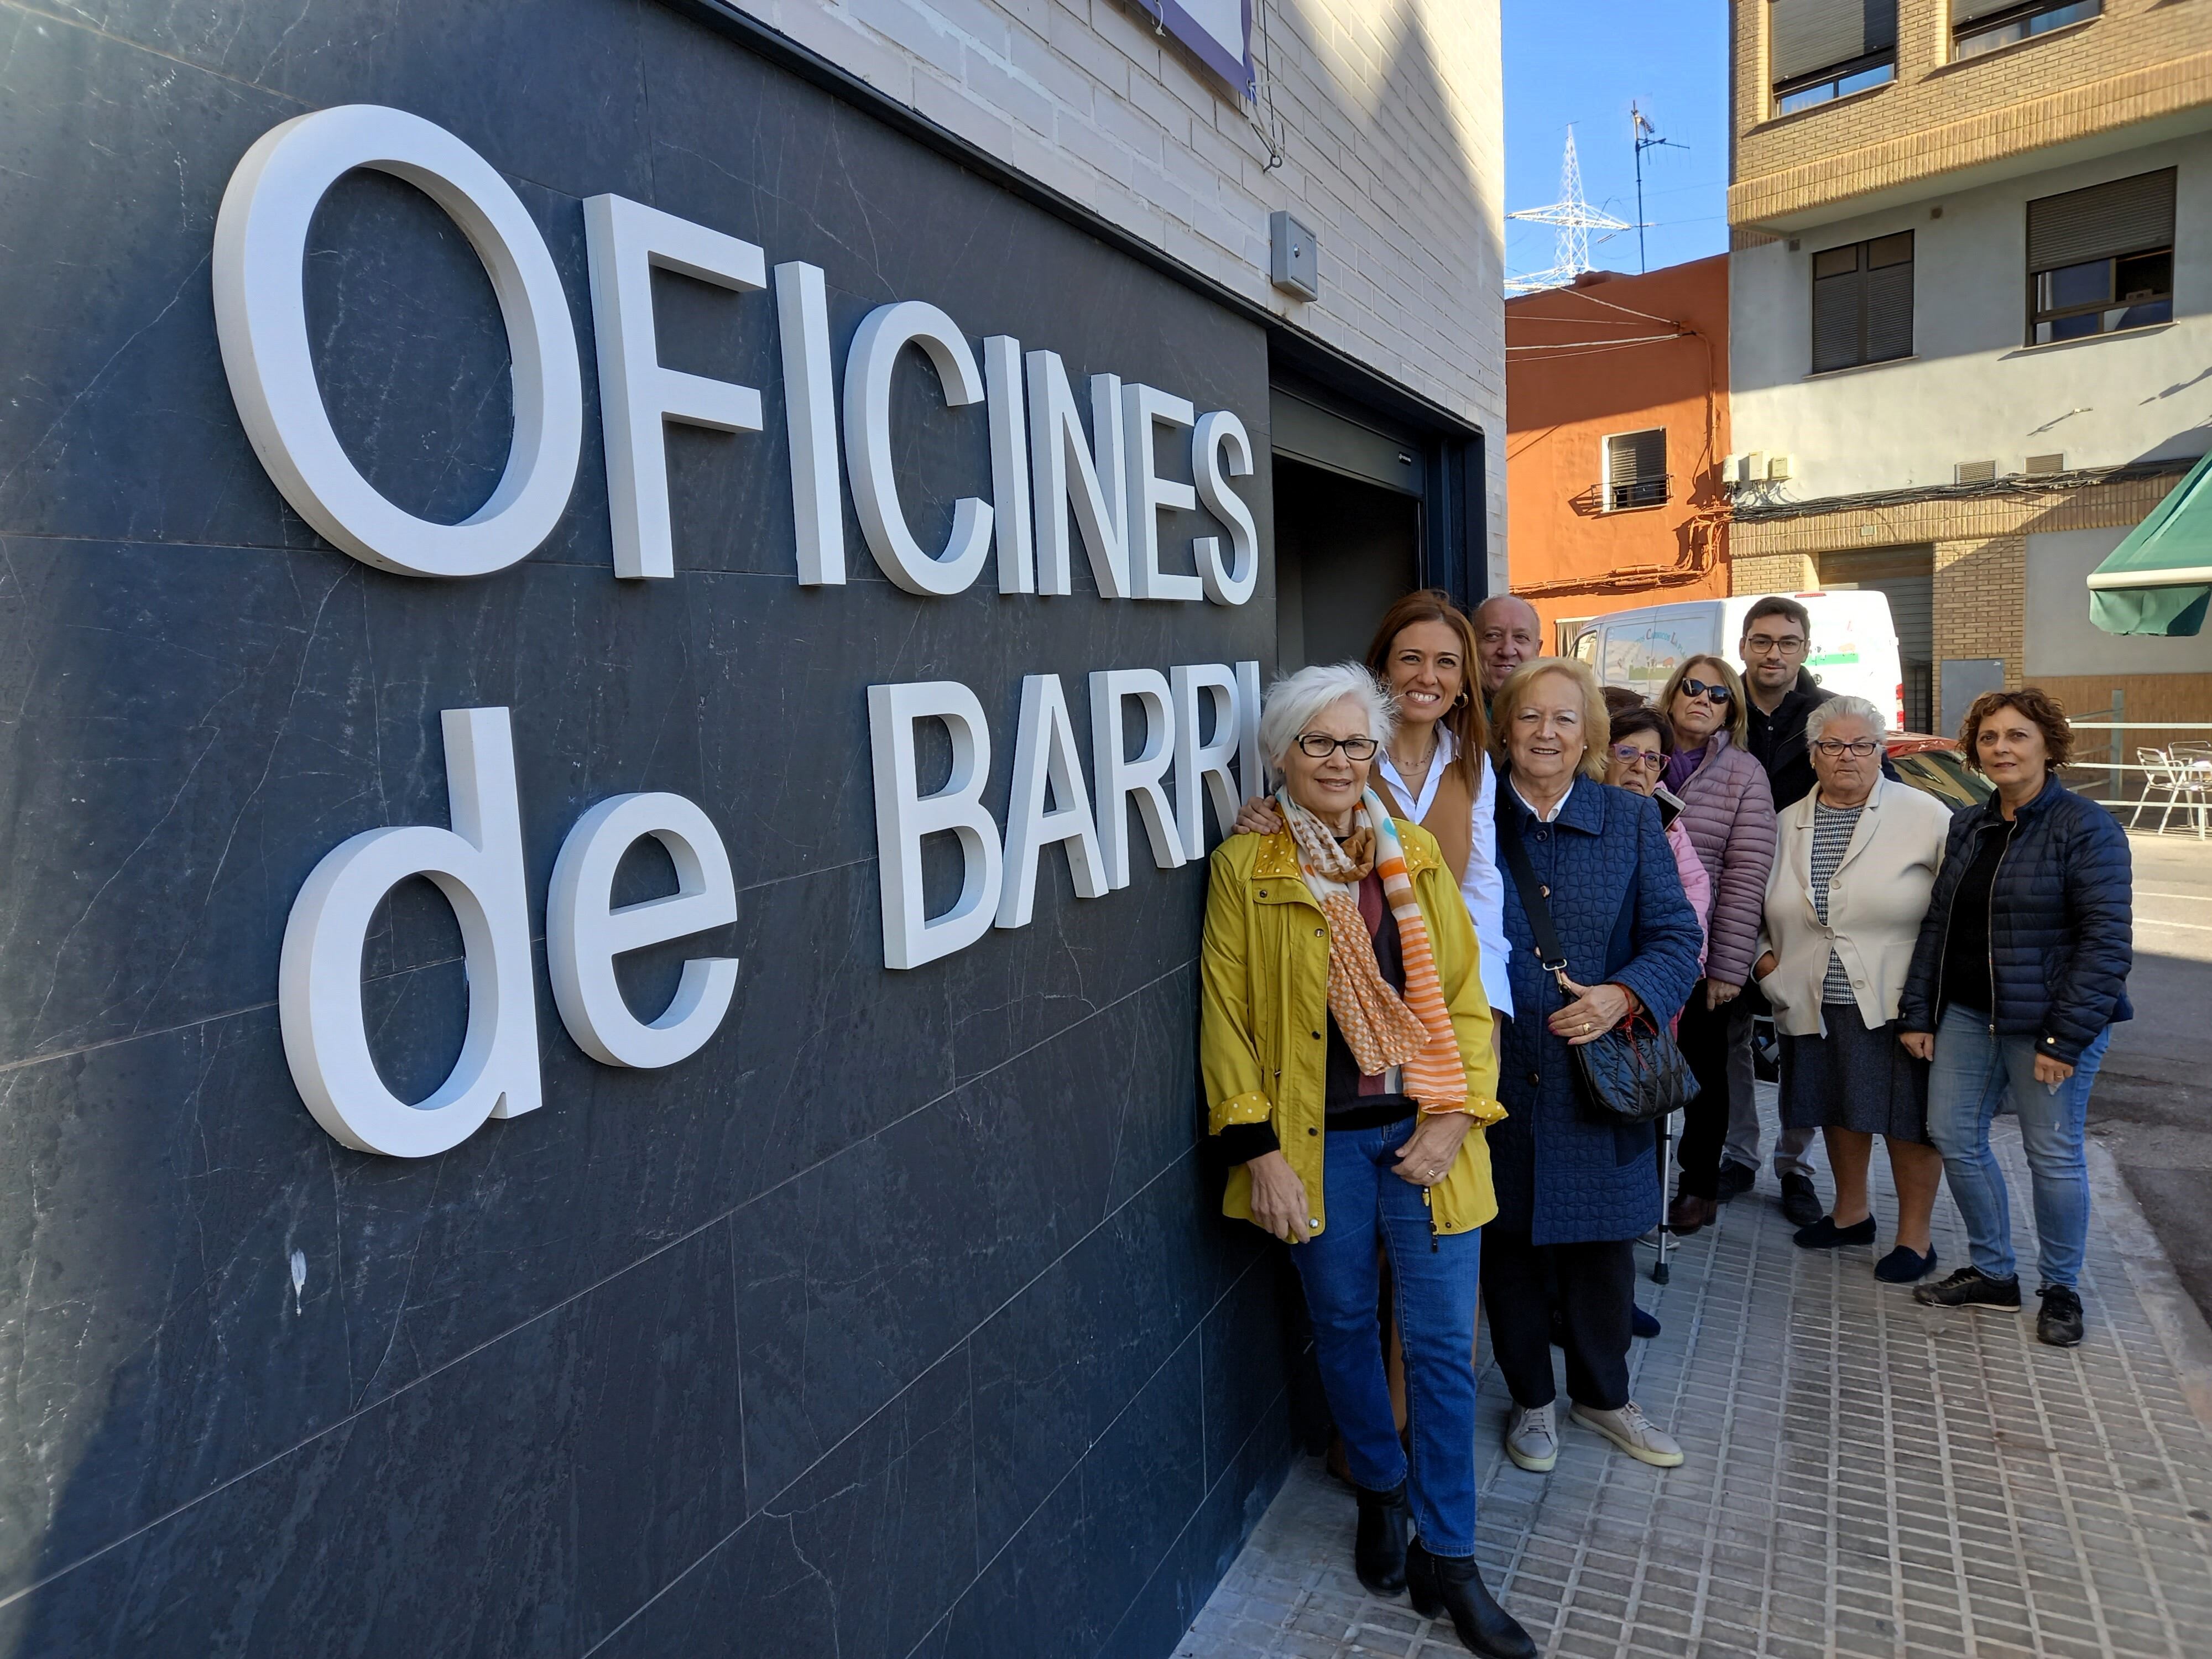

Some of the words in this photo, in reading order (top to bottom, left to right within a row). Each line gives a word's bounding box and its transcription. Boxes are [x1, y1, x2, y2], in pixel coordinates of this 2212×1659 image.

[212, 103, 1258, 607] OFICINES
[279, 706, 739, 1158] de
[867, 661, 1264, 970] BARRI
